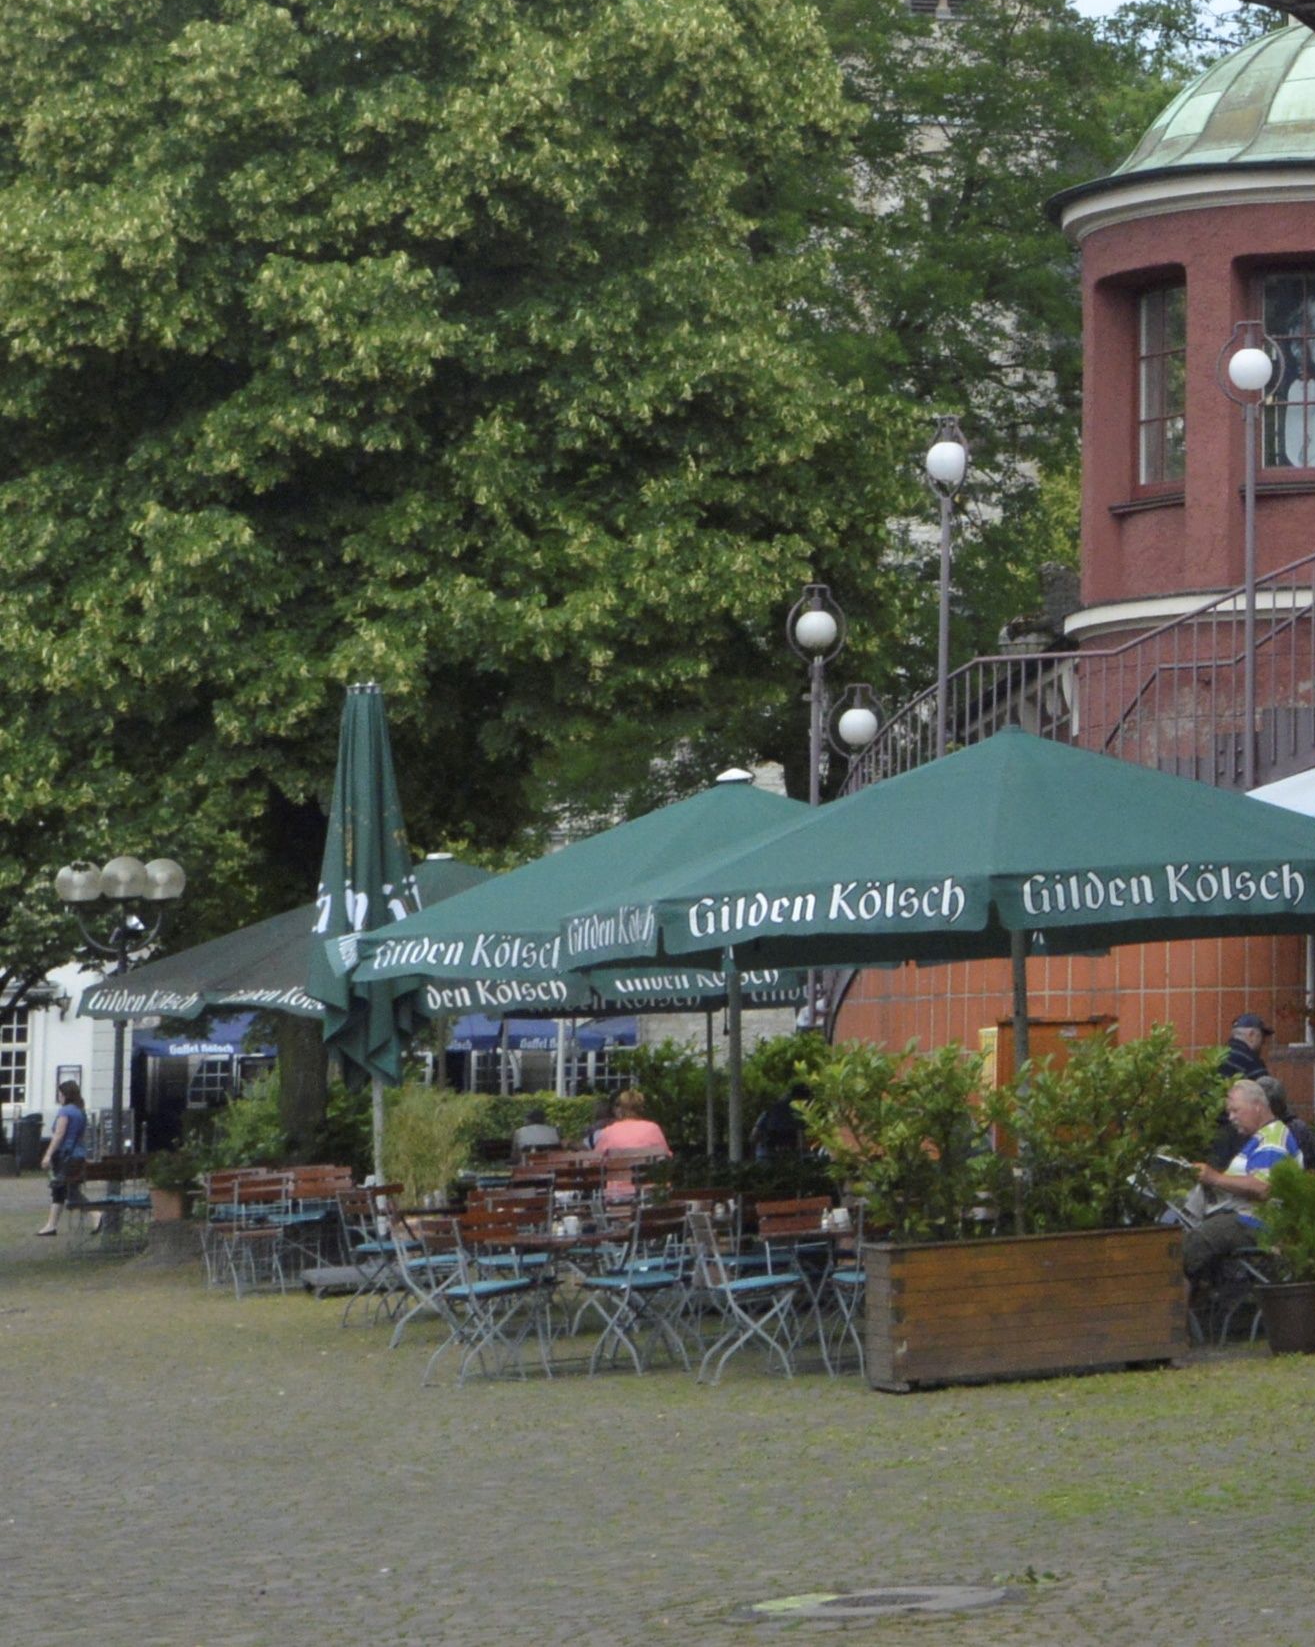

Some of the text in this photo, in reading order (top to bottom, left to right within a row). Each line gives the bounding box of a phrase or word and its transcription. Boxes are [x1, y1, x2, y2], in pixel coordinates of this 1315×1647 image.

[688, 877, 966, 937] Gilden Kölsch
[1022, 863, 1305, 915] Gilden Kölsch
[568, 915, 616, 955] Gilden
[373, 937, 464, 970] Gilden
[88, 988, 148, 1013] Gilden
[475, 979, 567, 1006] Kölsch
